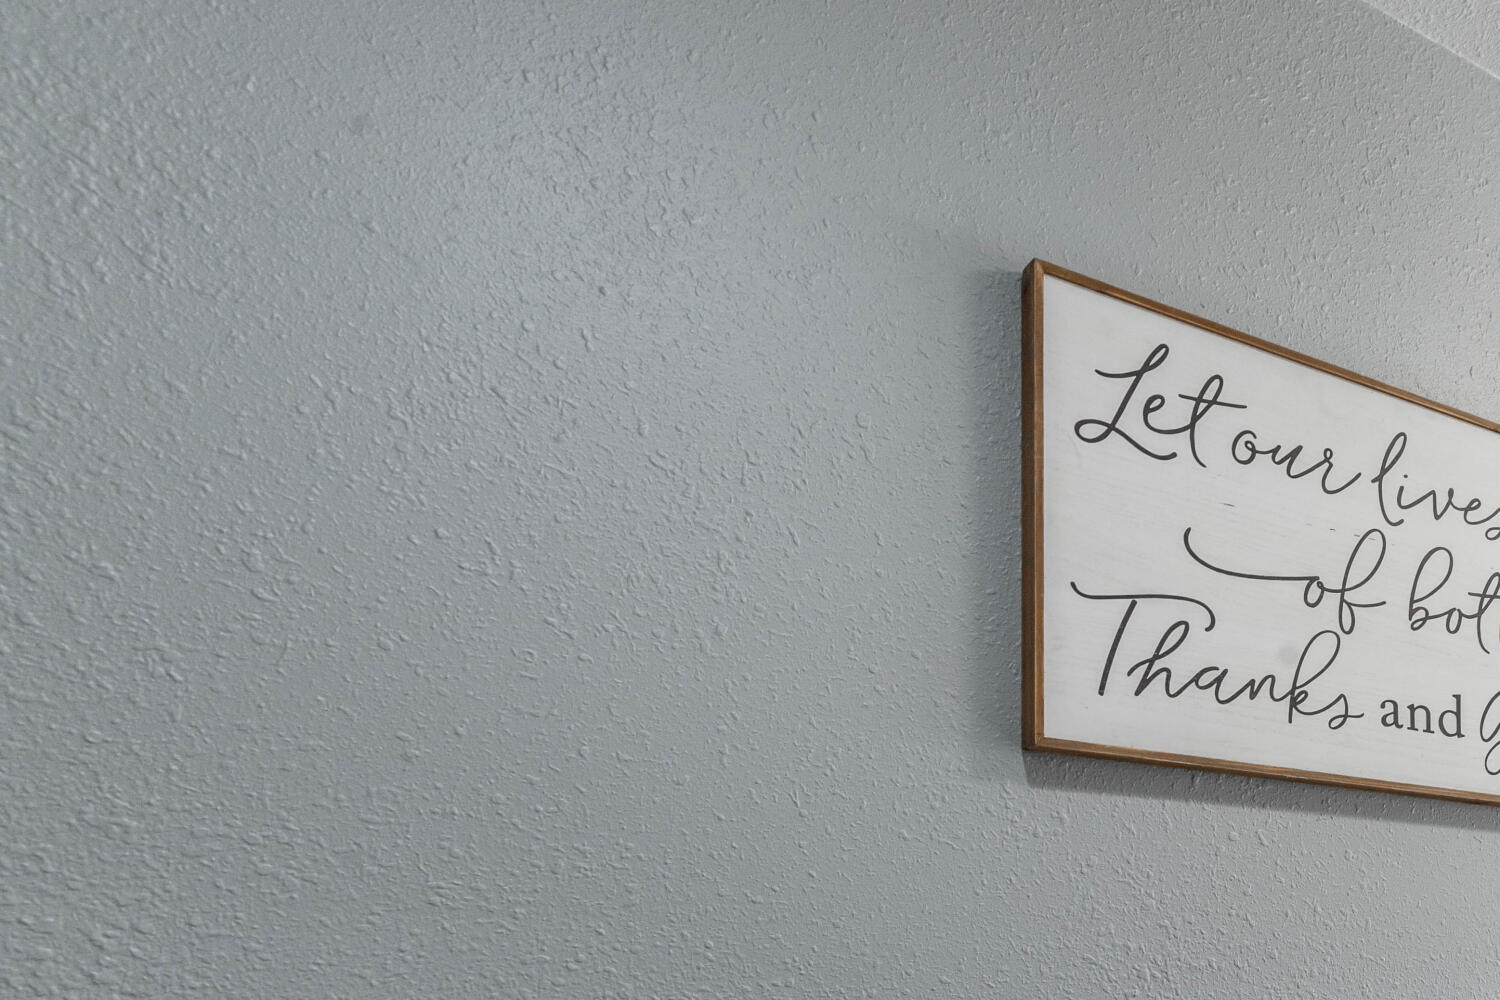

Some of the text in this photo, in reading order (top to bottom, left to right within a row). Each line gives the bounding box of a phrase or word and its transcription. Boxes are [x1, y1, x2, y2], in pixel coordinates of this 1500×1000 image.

[1073, 343, 1248, 469] Let
[1231, 429, 1362, 495] our
[1183, 526, 1387, 636] of
[1069, 581, 1365, 731] Thanks
[1379, 693, 1466, 739] and
